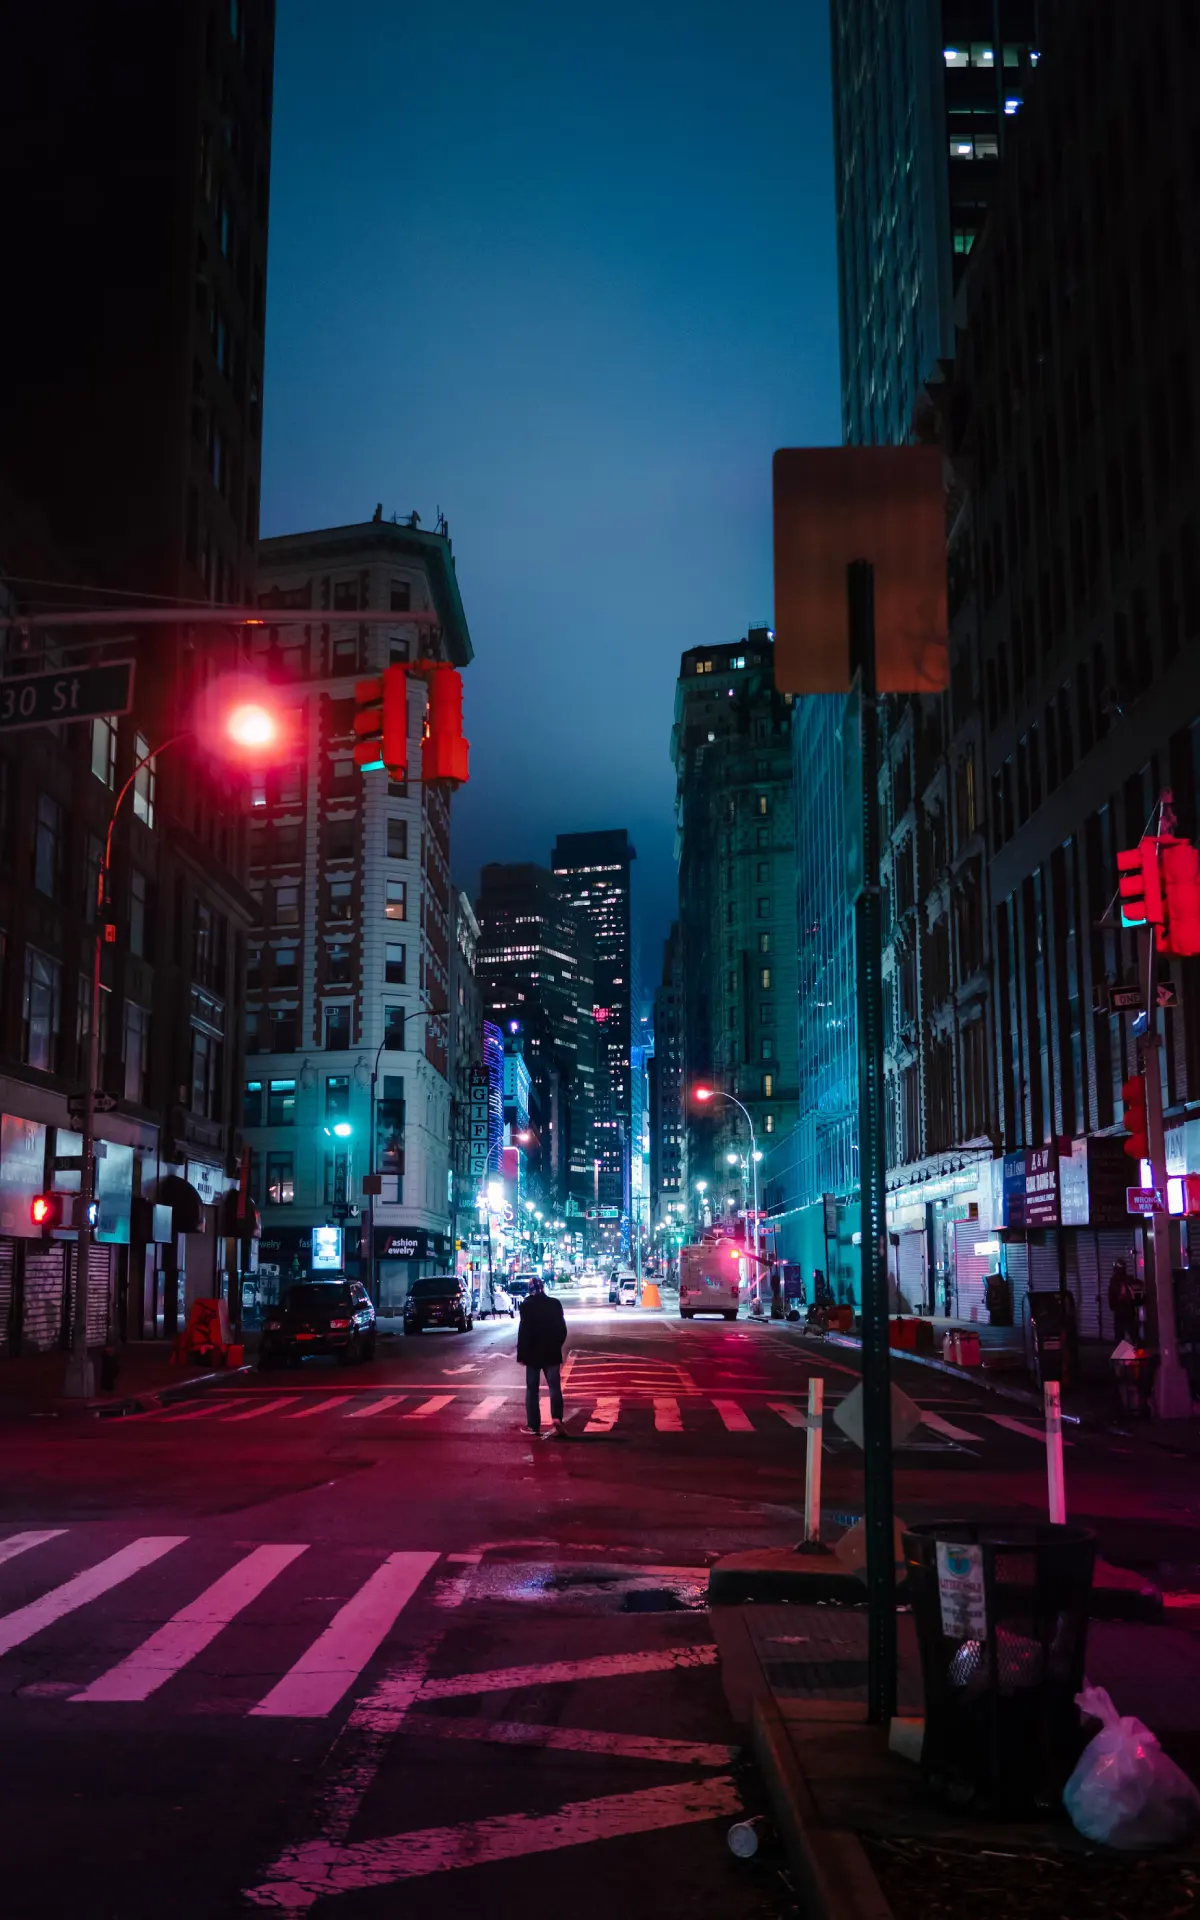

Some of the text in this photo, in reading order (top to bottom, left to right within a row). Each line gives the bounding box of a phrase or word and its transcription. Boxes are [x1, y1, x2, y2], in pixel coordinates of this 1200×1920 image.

[1, 679, 80, 719] 30 St
[473, 1088, 486, 1173] GIFTS
[1134, 1196, 1158, 1204] WRONG
